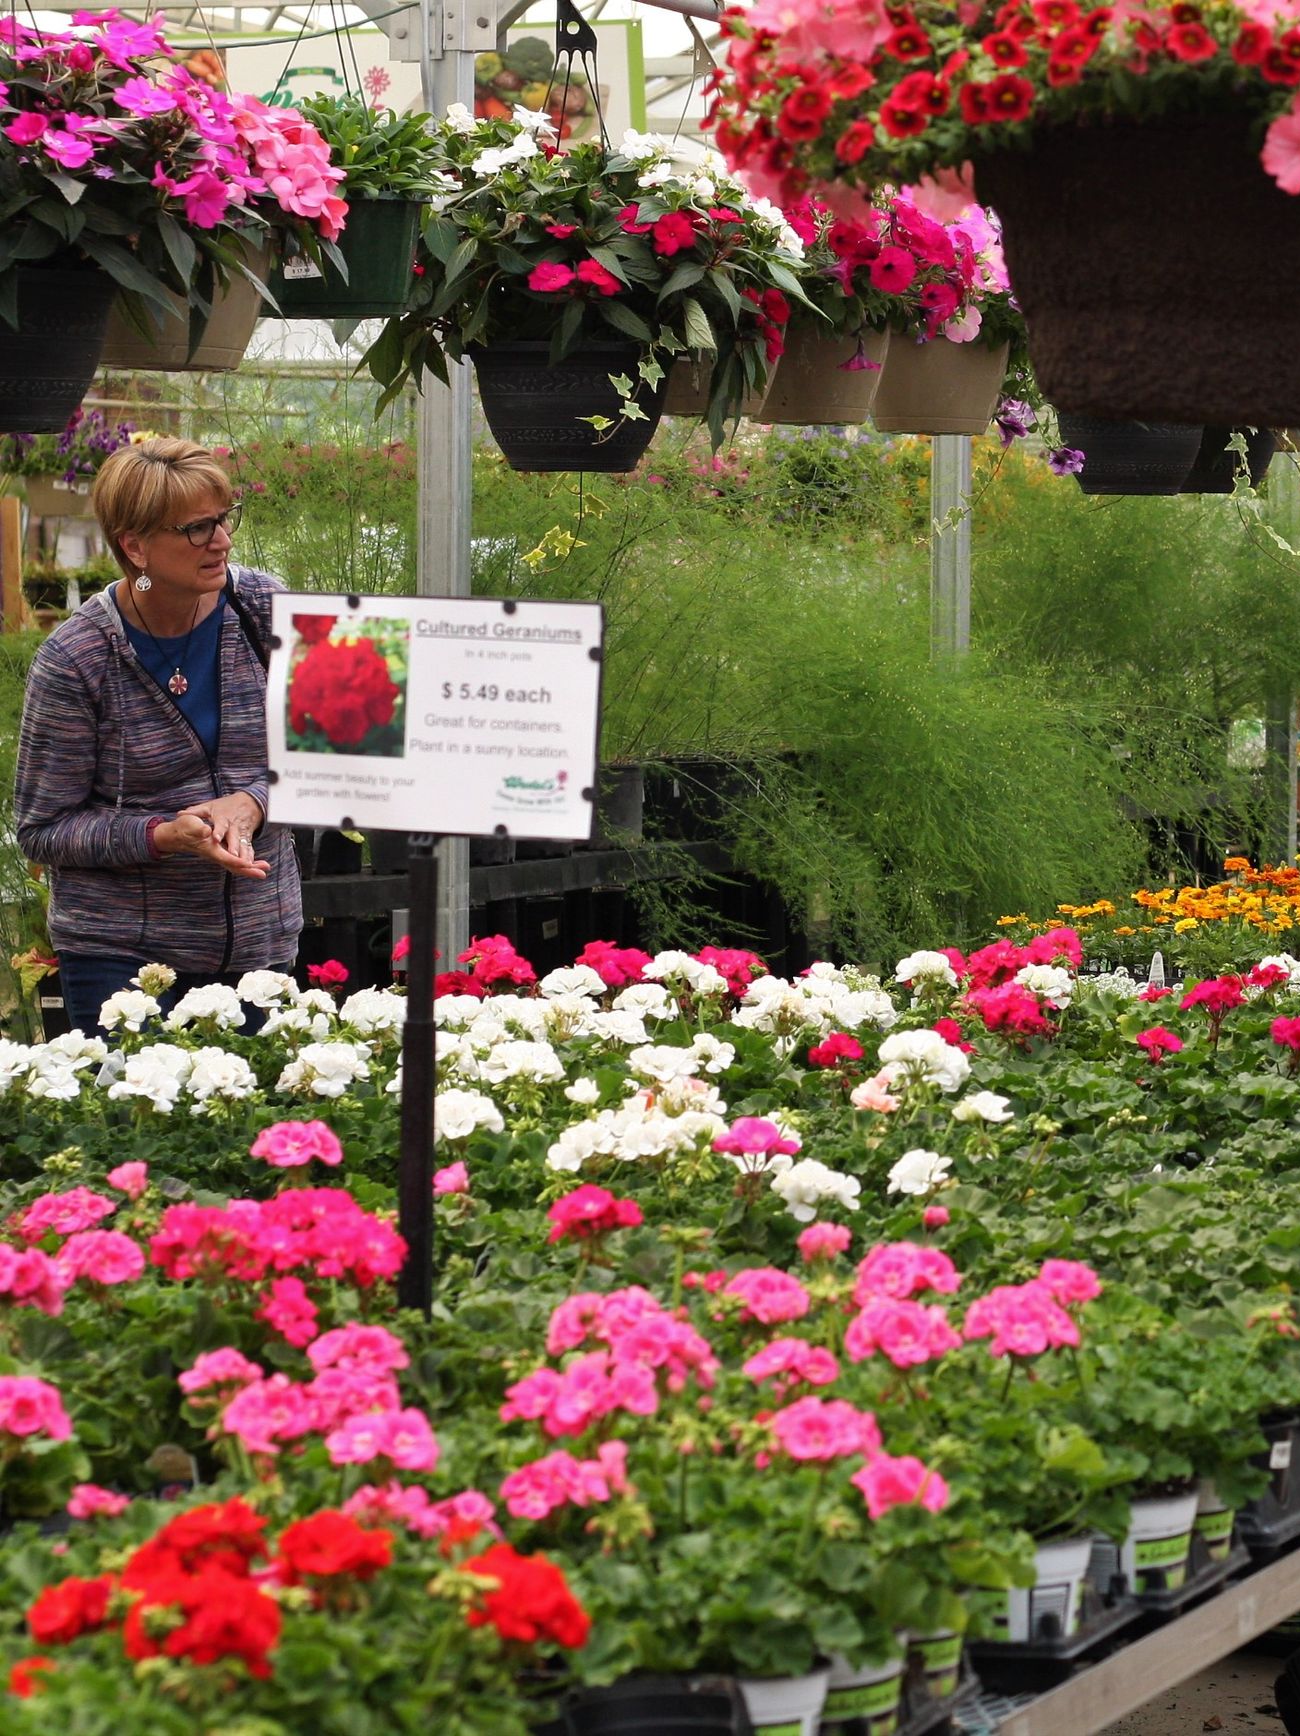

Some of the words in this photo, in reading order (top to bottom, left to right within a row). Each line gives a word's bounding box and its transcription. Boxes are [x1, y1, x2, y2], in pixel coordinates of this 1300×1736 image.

[416, 619, 487, 637] Cultured
[492, 622, 582, 641] Geraniums
[487, 650, 507, 660] inch
[442, 682, 452, 700] $
[459, 683, 499, 702] 5.49
[505, 687, 552, 704] each
[424, 713, 465, 728] Great
[468, 714, 487, 729] for
[409, 739, 443, 753] Plant
[447, 741, 459, 753] in
[462, 743, 471, 754] a
[475, 744, 513, 759] sunny
[283, 768, 302, 781] Add
[304, 771, 343, 784] summer
[345, 771, 378, 786] beauty
[379, 774, 389, 785] to
[392, 776, 416, 789] your
[296, 786, 332, 800] garden
[333, 787, 351, 800] with
